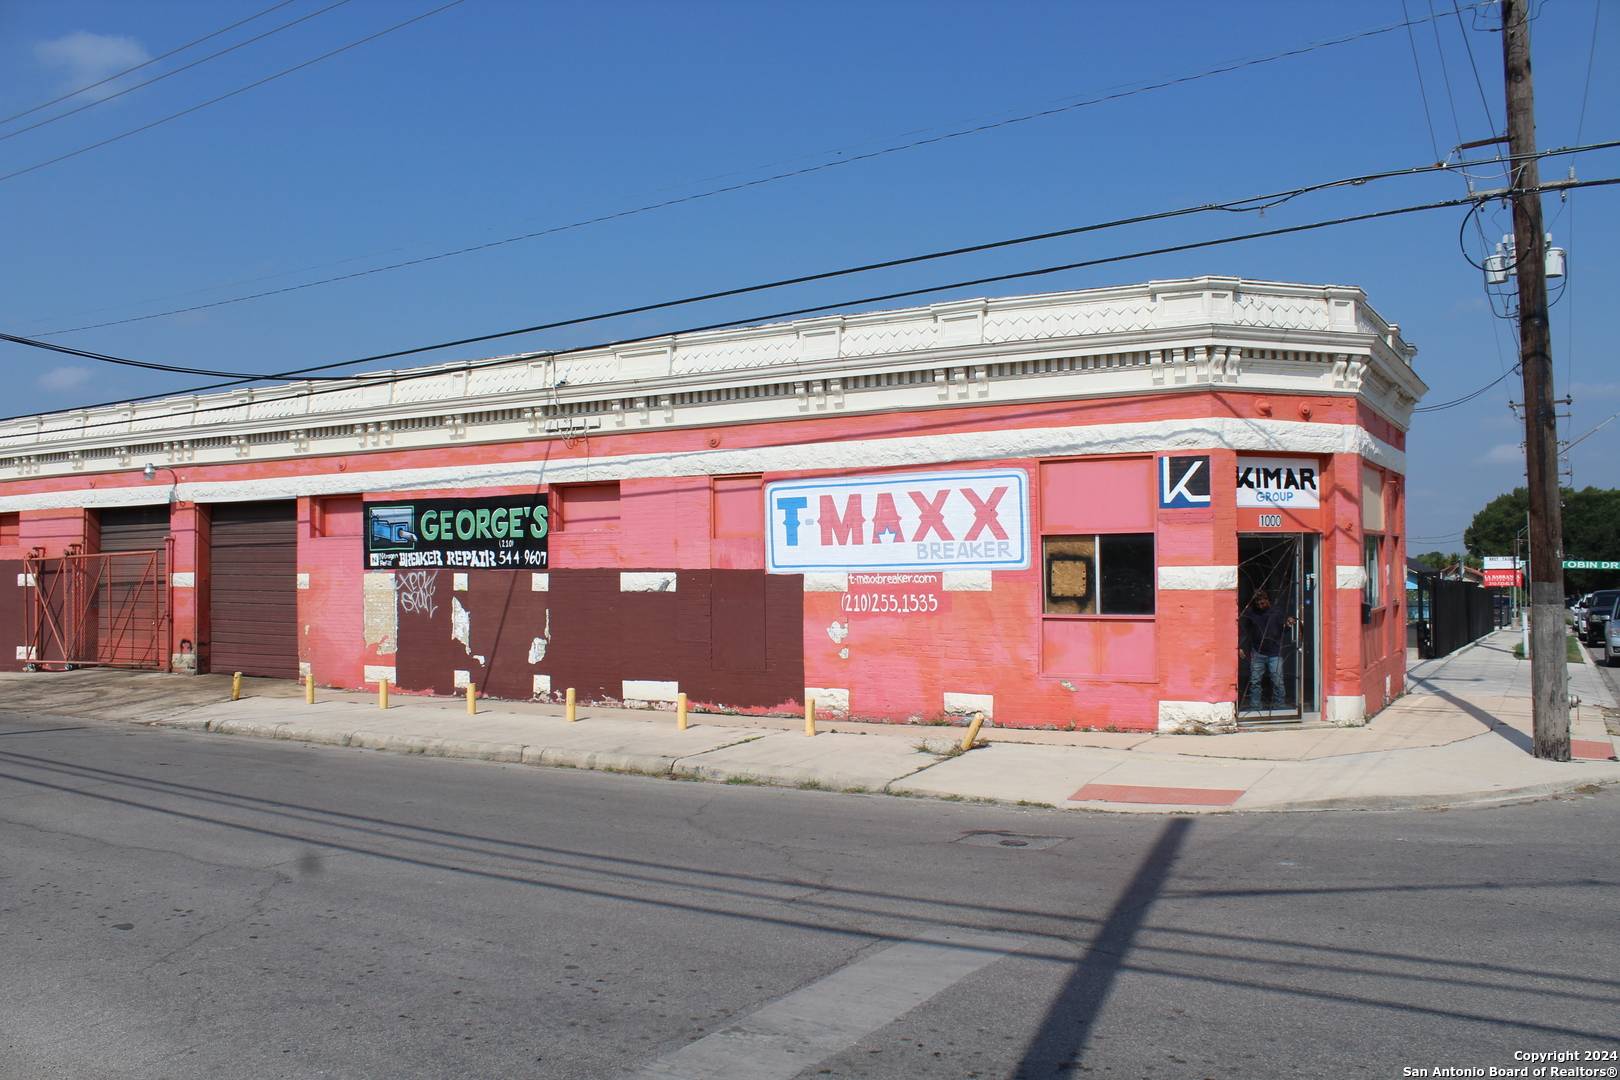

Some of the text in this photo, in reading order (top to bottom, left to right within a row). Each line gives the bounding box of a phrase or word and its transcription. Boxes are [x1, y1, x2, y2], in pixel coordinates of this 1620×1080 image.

[1236, 467, 1316, 490] KIMAR
[1256, 491, 1293, 502] GROUP
[420, 505, 548, 541] GEORGE'S
[1260, 515, 1281, 527] 1000
[499, 540, 514, 548] (210)
[917, 541, 1013, 560] BREAKER
[399, 550, 443, 567] BREAKER
[446, 550, 496, 567] REPAIR
[1602, 561, 1619, 569] DR
[848, 573, 937, 584] t-maxxbreaker.com
